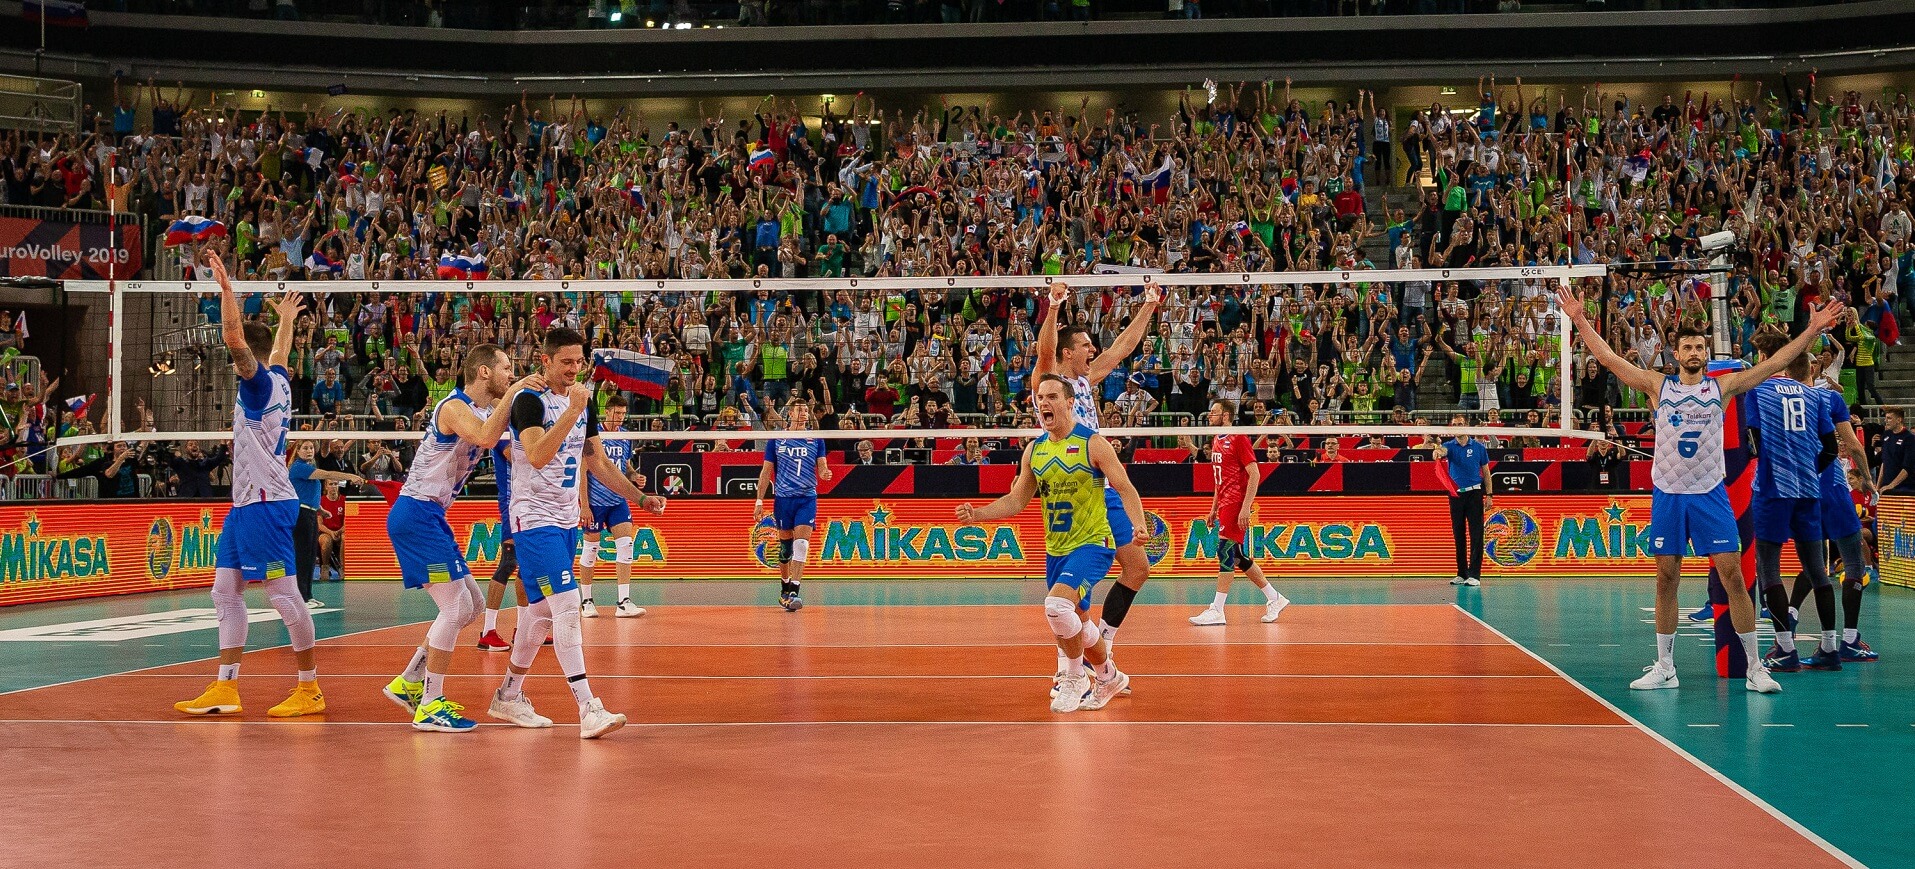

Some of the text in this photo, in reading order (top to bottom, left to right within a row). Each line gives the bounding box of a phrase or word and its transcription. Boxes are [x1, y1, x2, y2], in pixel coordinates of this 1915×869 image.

[88, 247, 130, 264] 2019
[1781, 396, 1807, 432] 18
[606, 446, 623, 456] VTB
[787, 447, 808, 457] VTB
[1677, 431, 1703, 459] 6
[560, 456, 577, 488] 9
[794, 458, 802, 477] 7
[1502, 476, 1525, 485] CEV
[590, 522, 599, 530] 24
[821, 520, 1025, 560] MIKASA
[1554, 517, 1654, 558] MIK
[1655, 537, 1665, 549] 6
[0, 533, 110, 583] MIKASA
[561, 570, 571, 585] 9
